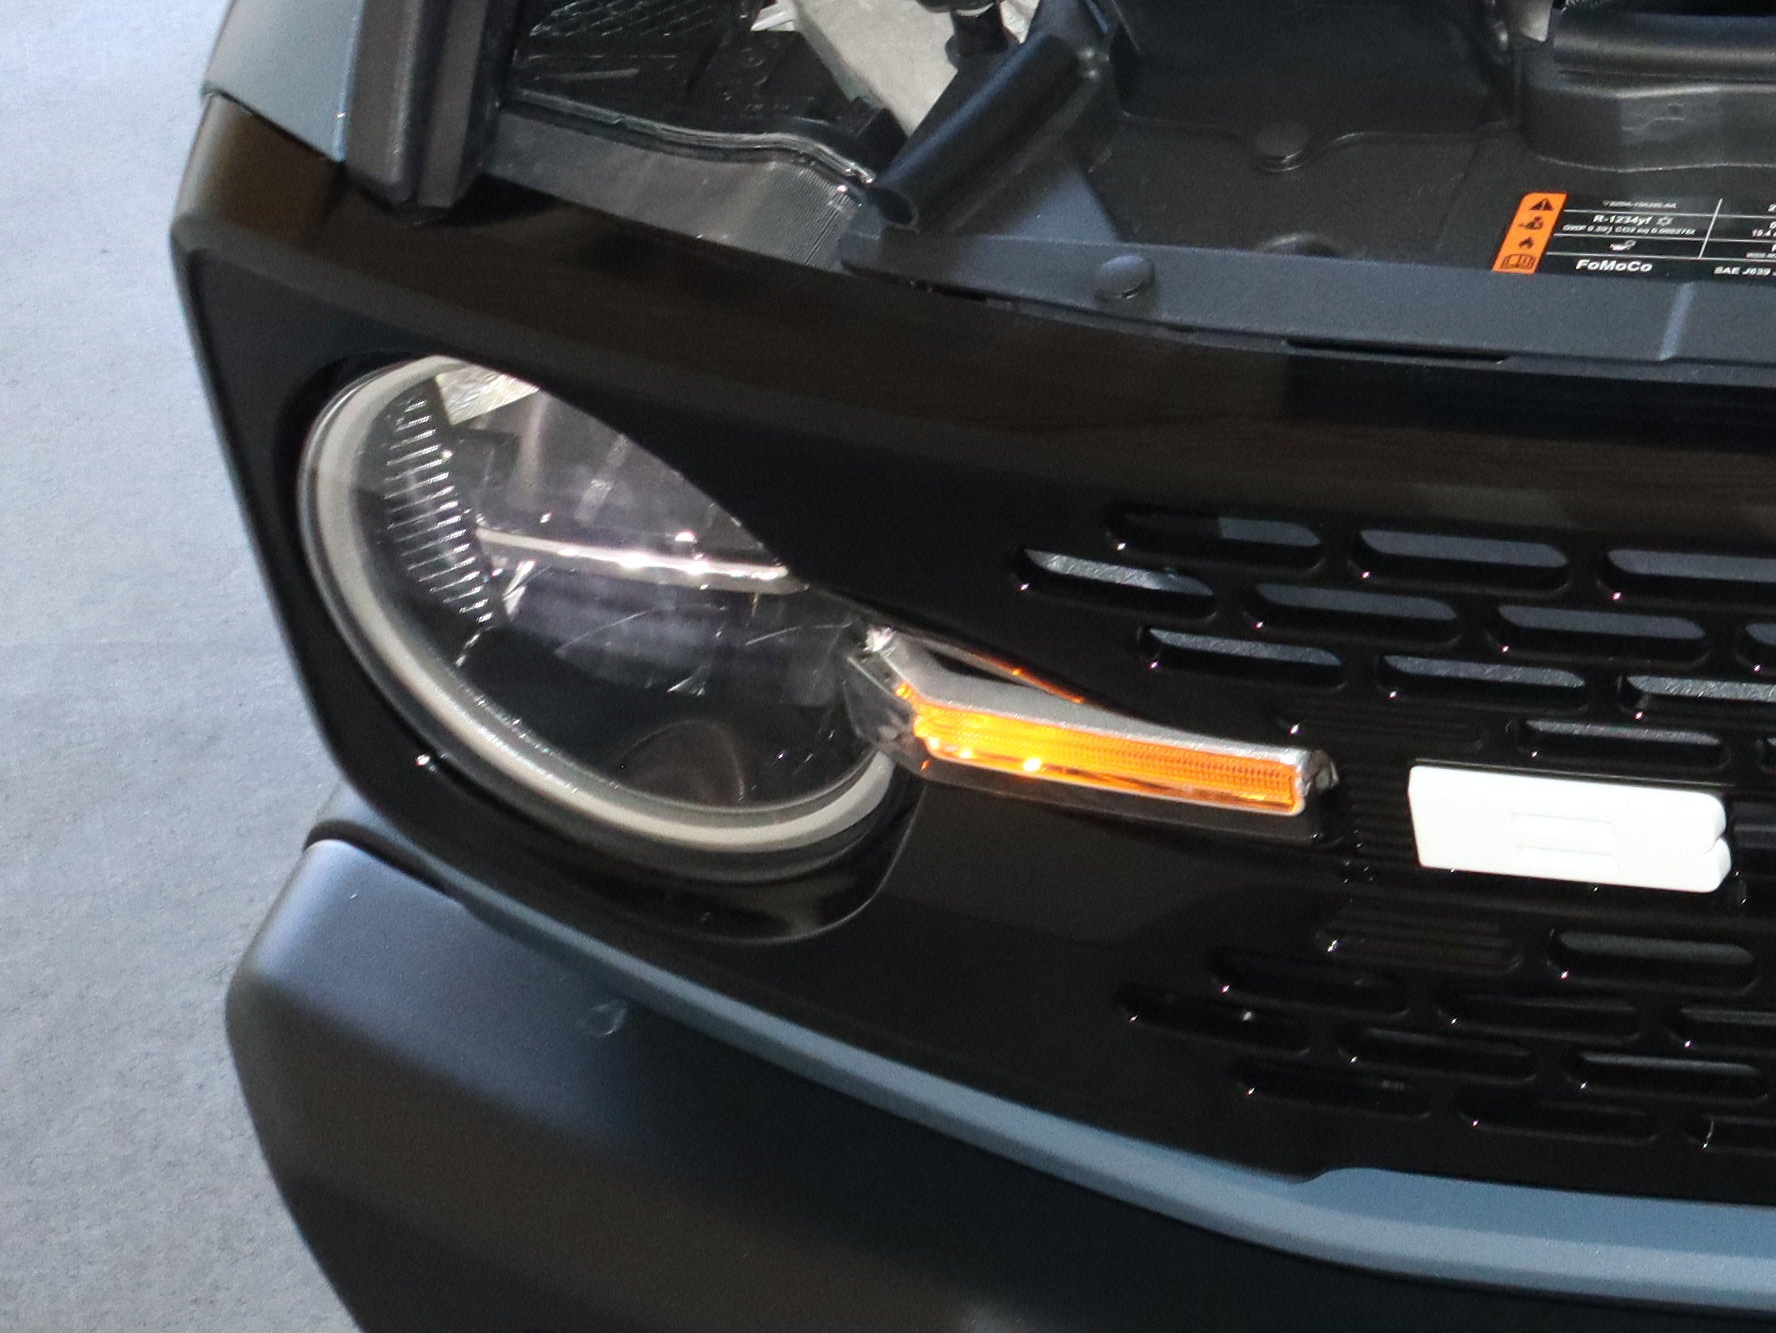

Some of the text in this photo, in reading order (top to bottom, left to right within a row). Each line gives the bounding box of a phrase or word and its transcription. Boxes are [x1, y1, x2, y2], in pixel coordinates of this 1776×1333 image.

[1593, 214, 1653, 226] R-1234yf
[1575, 258, 1654, 273] FoMoCo
[1713, 266, 1740, 275] SAE
